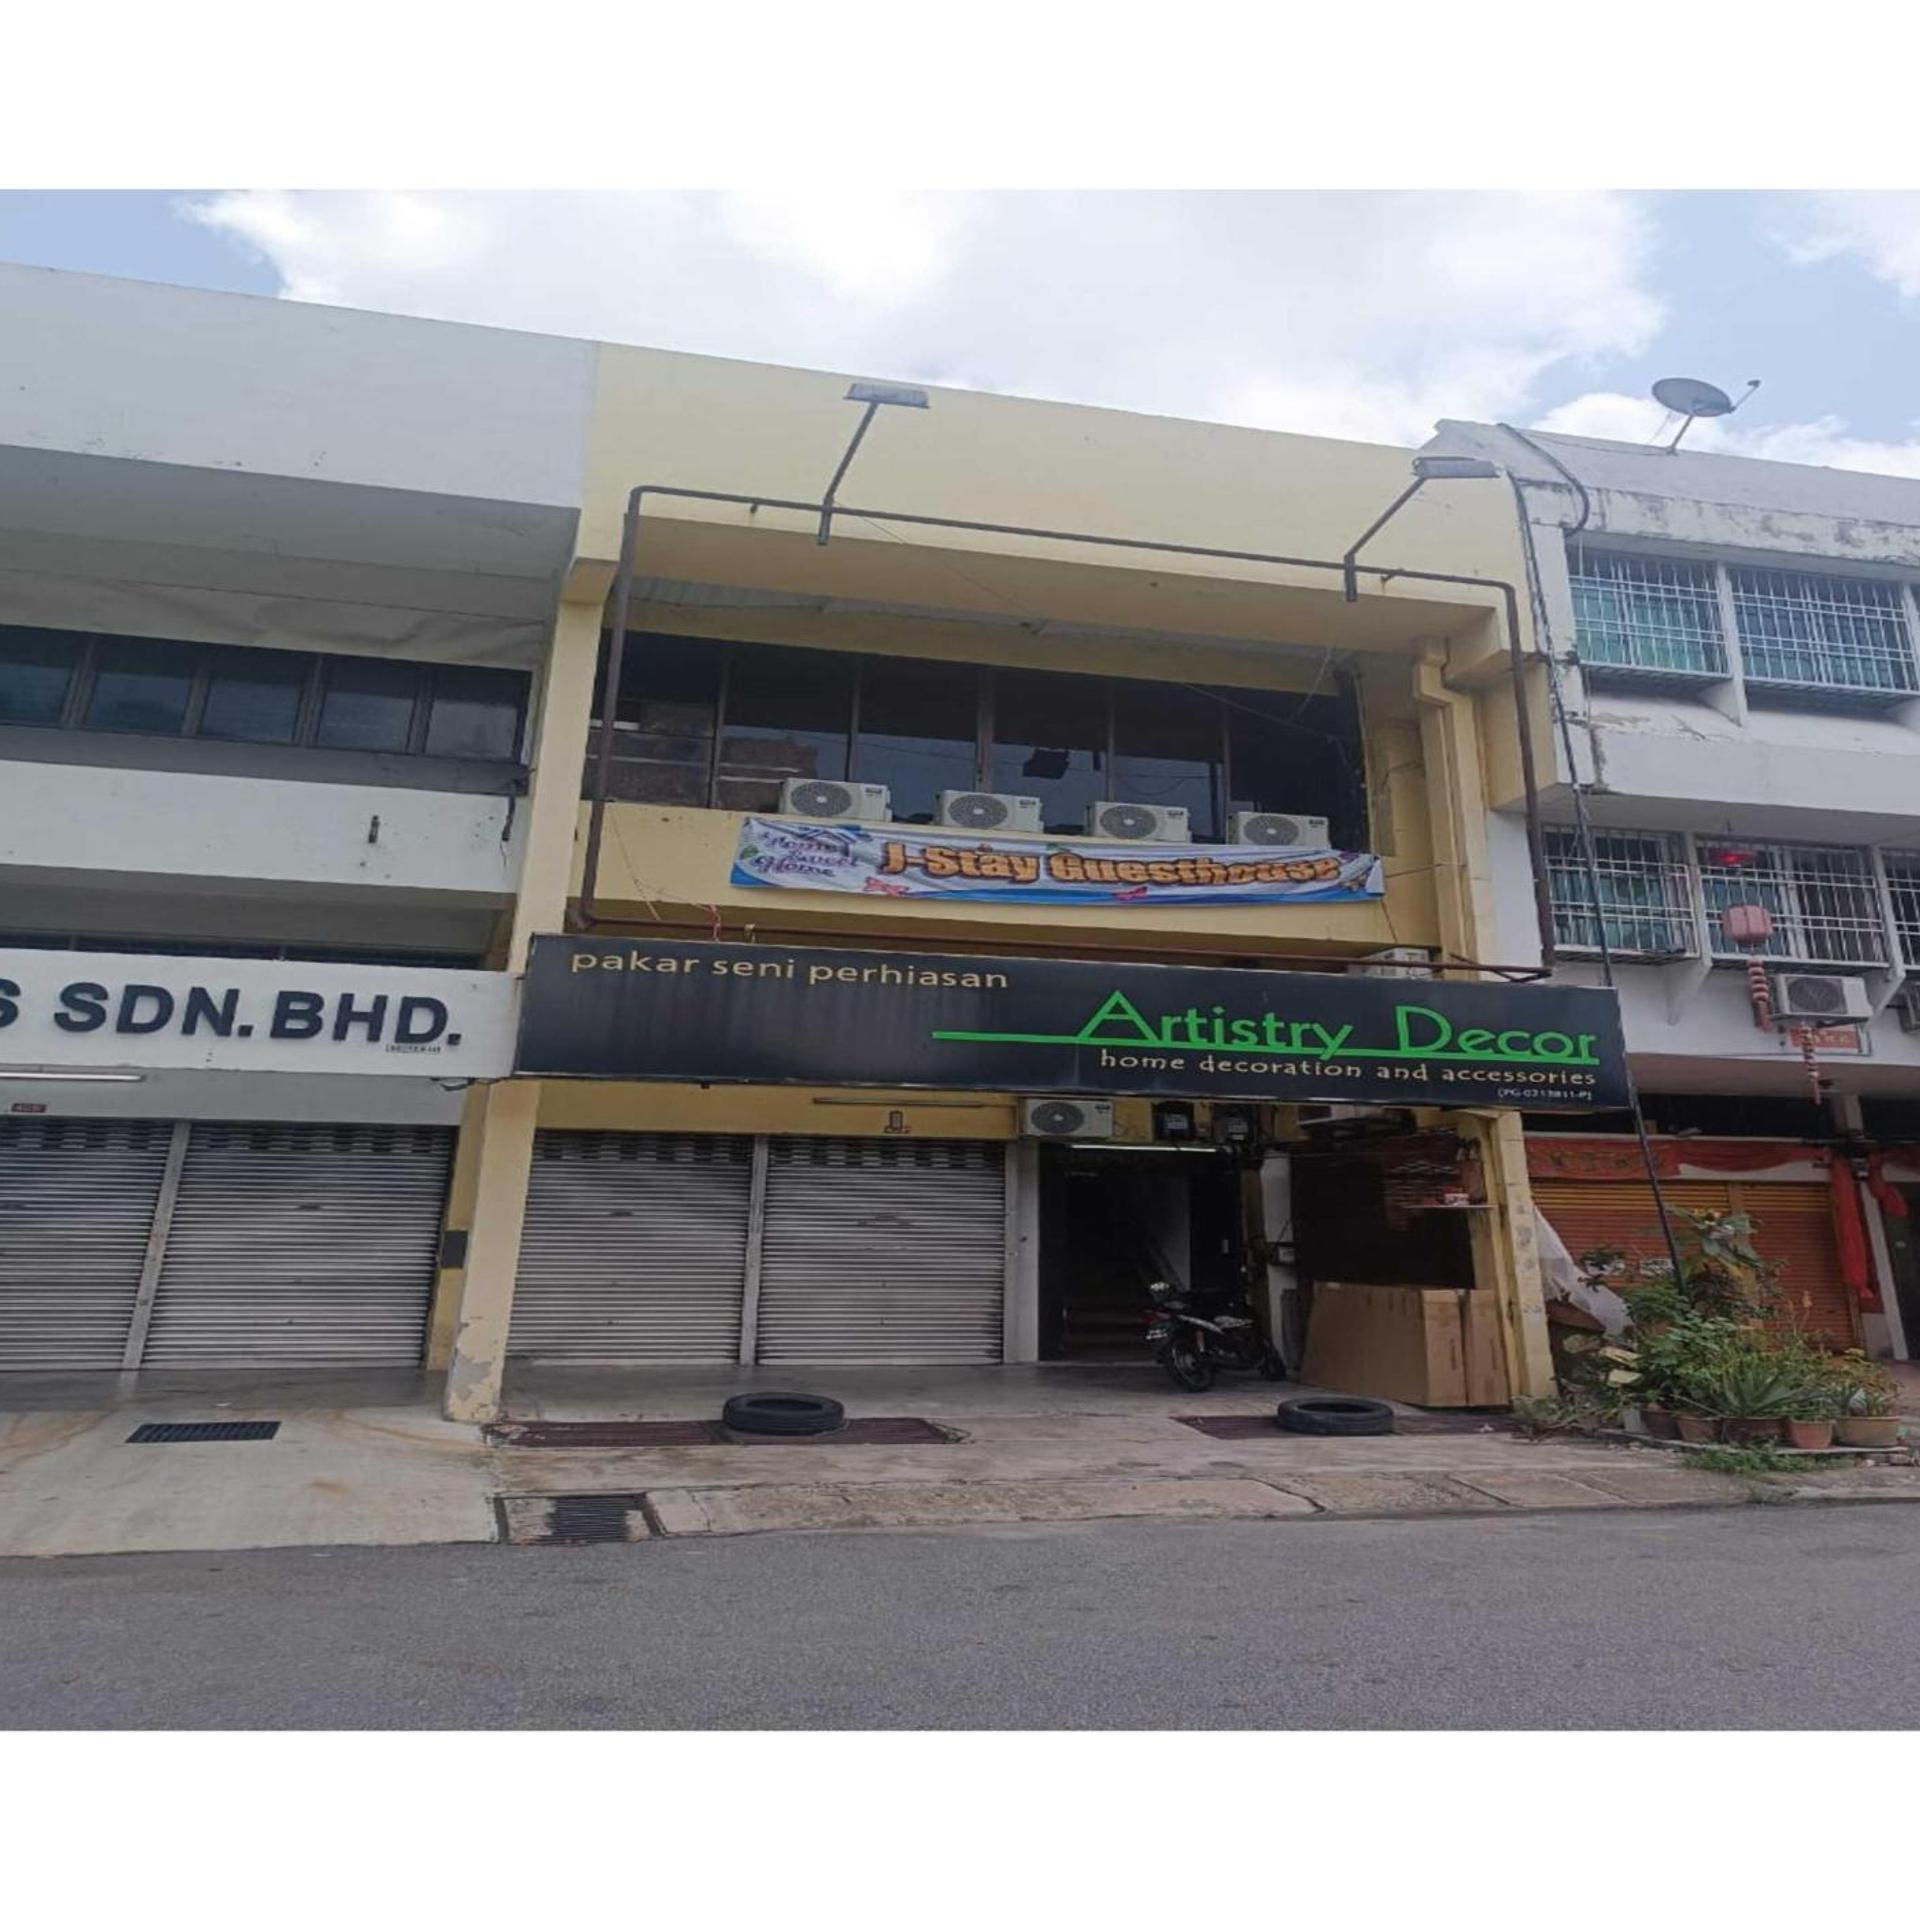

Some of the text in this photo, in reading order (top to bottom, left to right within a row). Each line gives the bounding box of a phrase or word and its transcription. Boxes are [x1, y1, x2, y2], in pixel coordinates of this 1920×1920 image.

[878, 841, 1342, 887] J-Stay Guesthouse
[571, 950, 1009, 989] pakar seni perhiasan
[1077, 989, 1598, 1062] Artistry Decor
[1101, 1048, 1597, 1086] home decoration and accessories
